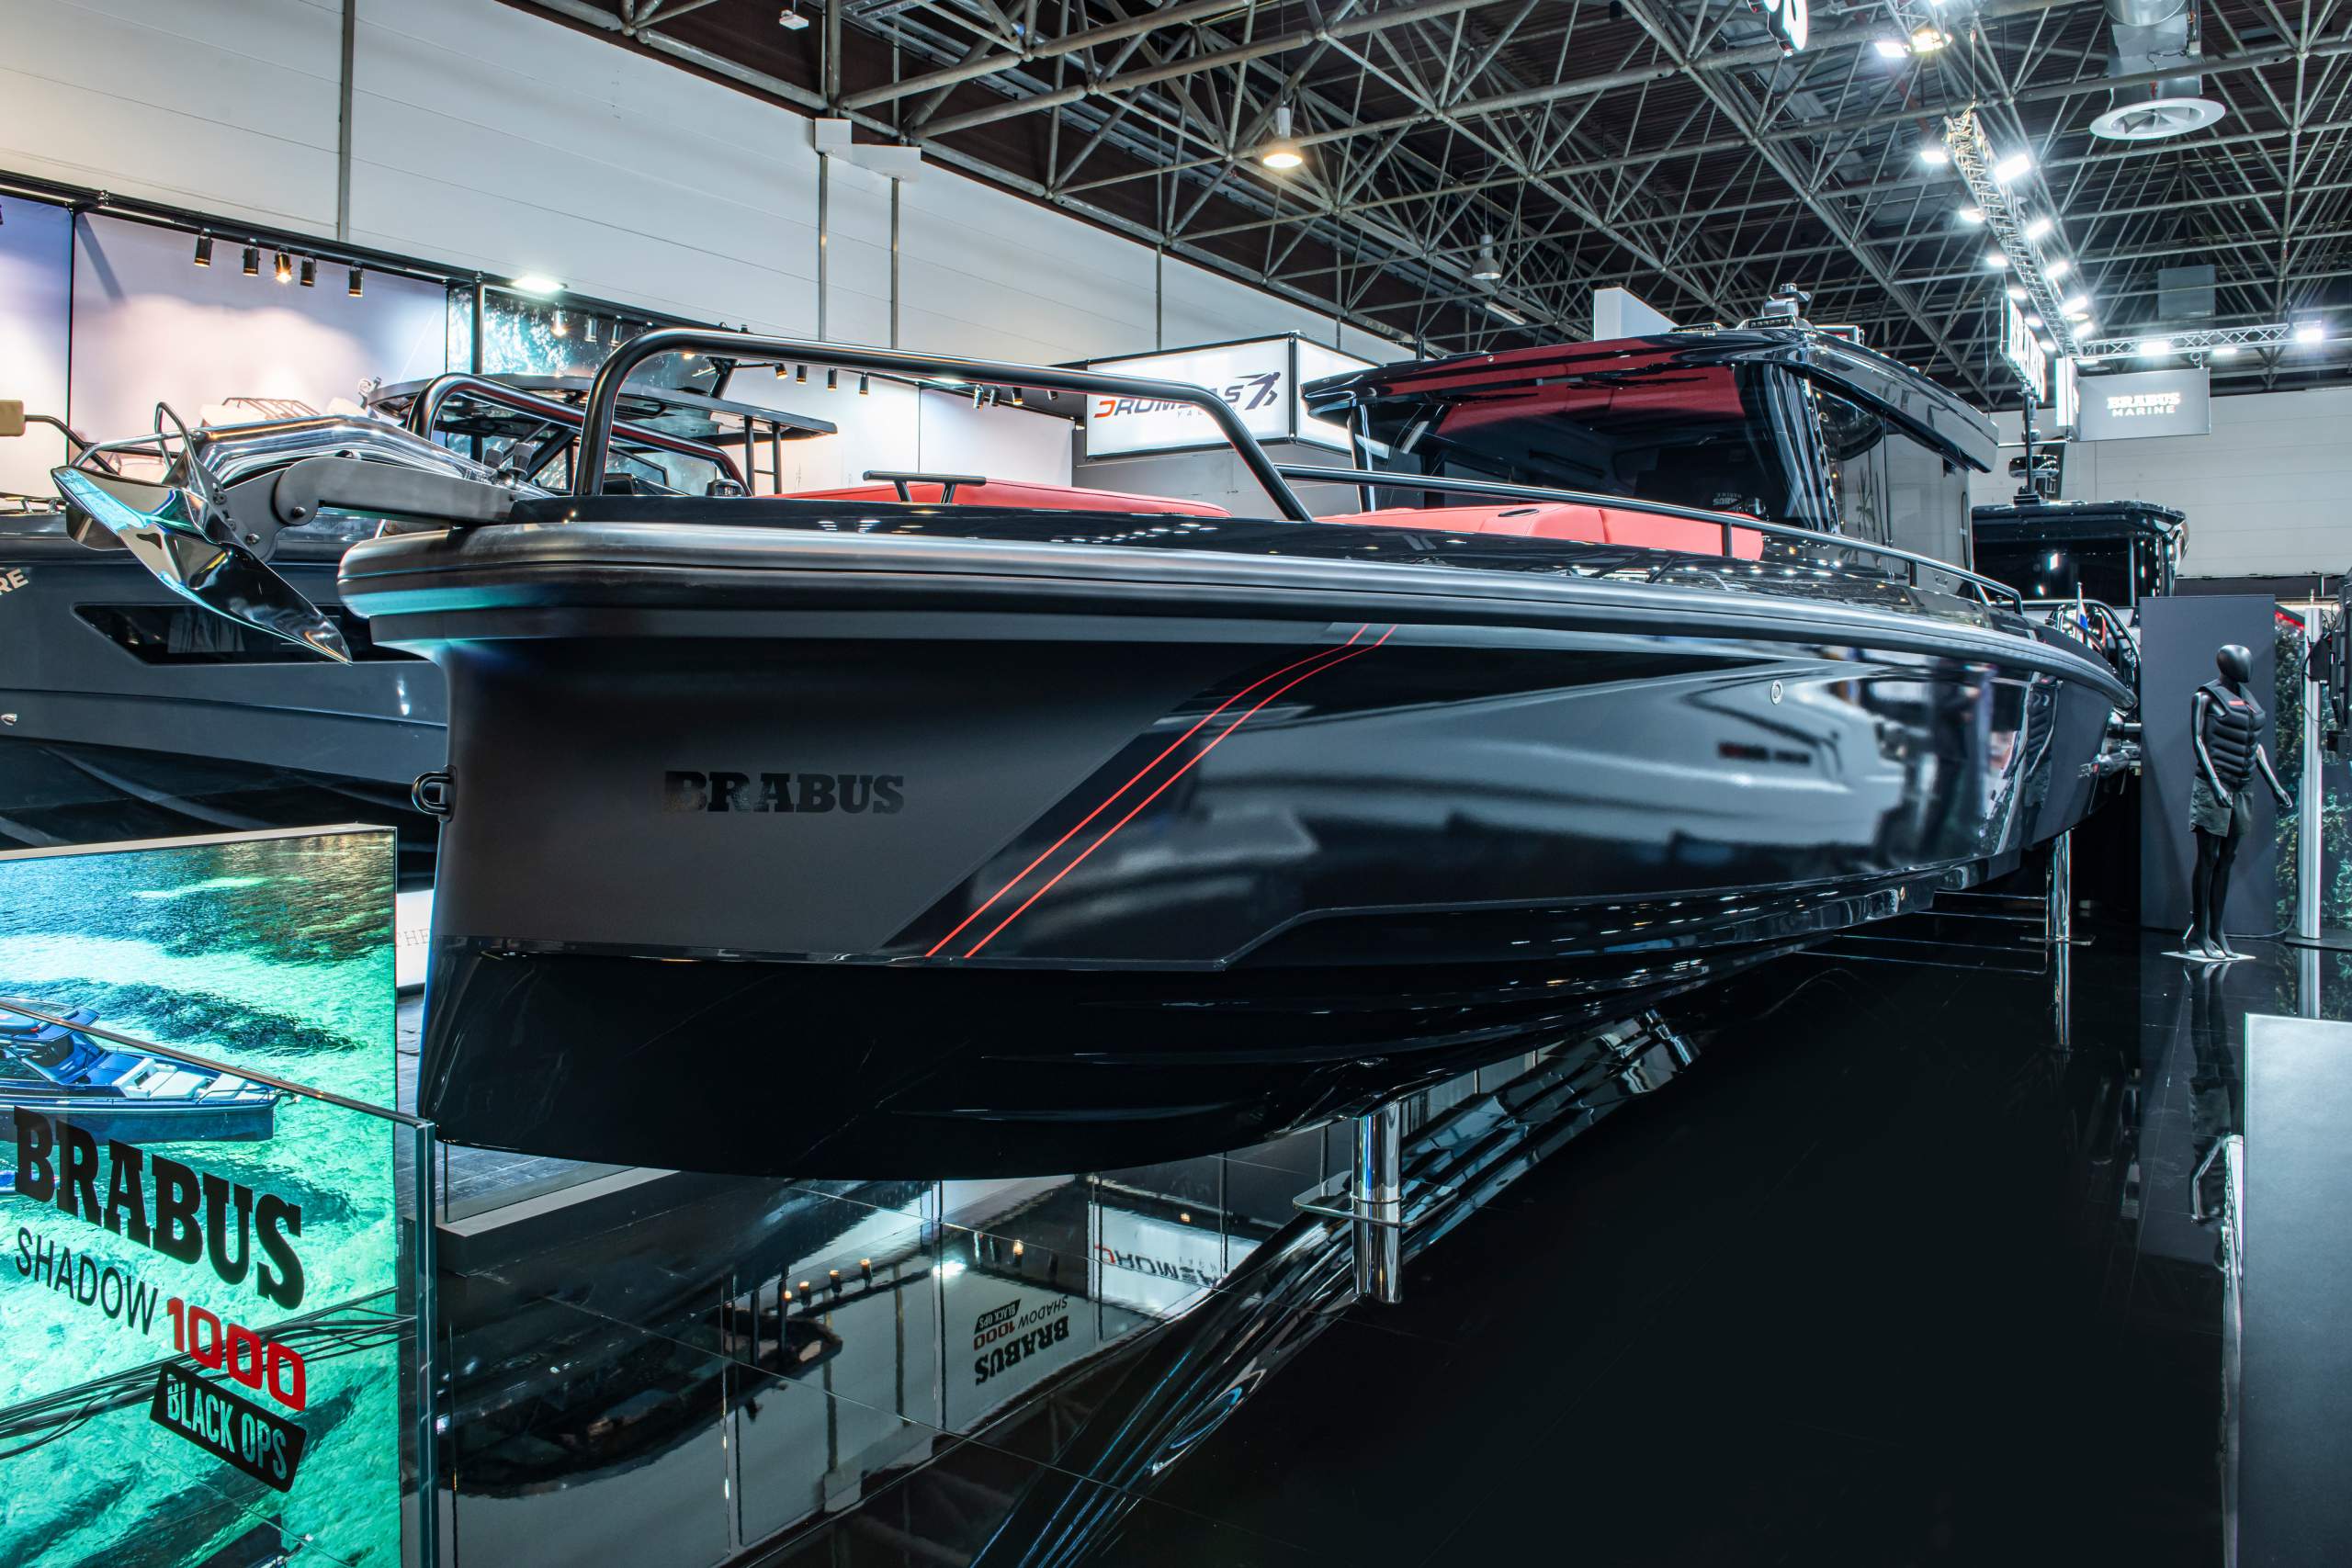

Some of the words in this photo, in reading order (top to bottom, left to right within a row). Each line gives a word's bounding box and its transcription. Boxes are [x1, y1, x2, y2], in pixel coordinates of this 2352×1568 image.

[2107, 392, 2180, 410] BRABUS
[2112, 405, 2176, 417] MARINE
[662, 771, 905, 815] BRABUS
[14, 1105, 305, 1310] BRABUS
[16, 1226, 159, 1337] SHADOW
[166, 1296, 306, 1412] 1000
[1017, 1295, 1069, 1329] SHADOW
[975, 1315, 1069, 1385] BRABUS
[167, 1373, 235, 1453] BLACK
[242, 1413, 288, 1480] OPS
